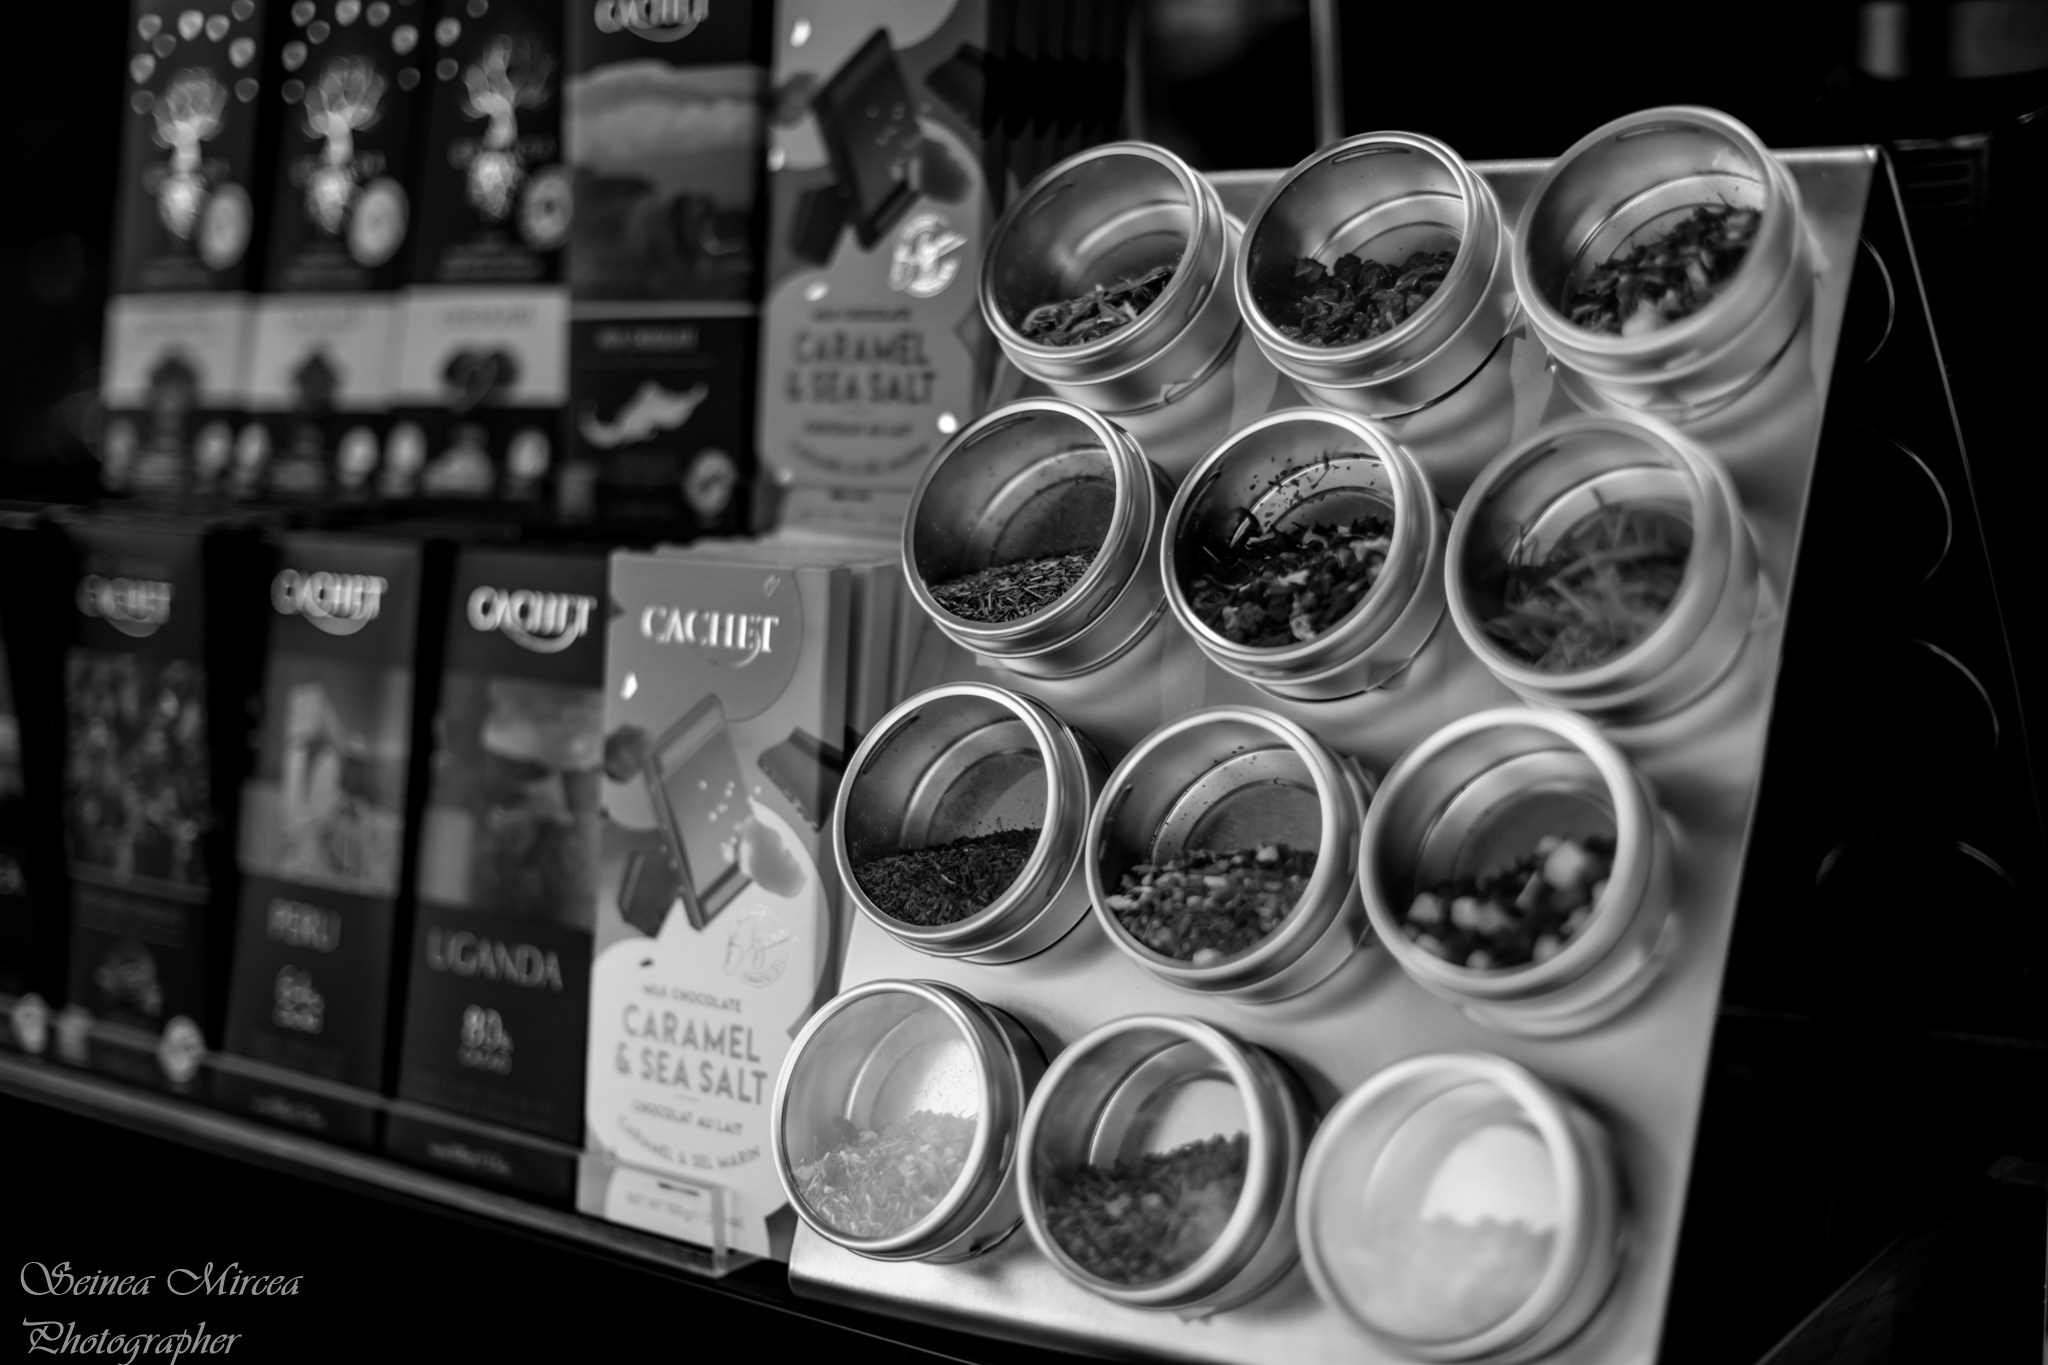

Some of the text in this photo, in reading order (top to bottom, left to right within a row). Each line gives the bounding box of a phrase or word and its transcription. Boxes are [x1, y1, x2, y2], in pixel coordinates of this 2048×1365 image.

[640, 605, 779, 666] CACHET
[426, 925, 563, 993] UGANDA
[671, 986, 742, 1014] CHOCOLATE
[622, 1002, 761, 1063] CARAMEL
[615, 1041, 768, 1105] & SEA SALT
[716, 1116, 743, 1137] LAIT
[716, 1145, 762, 1169] MARIN
